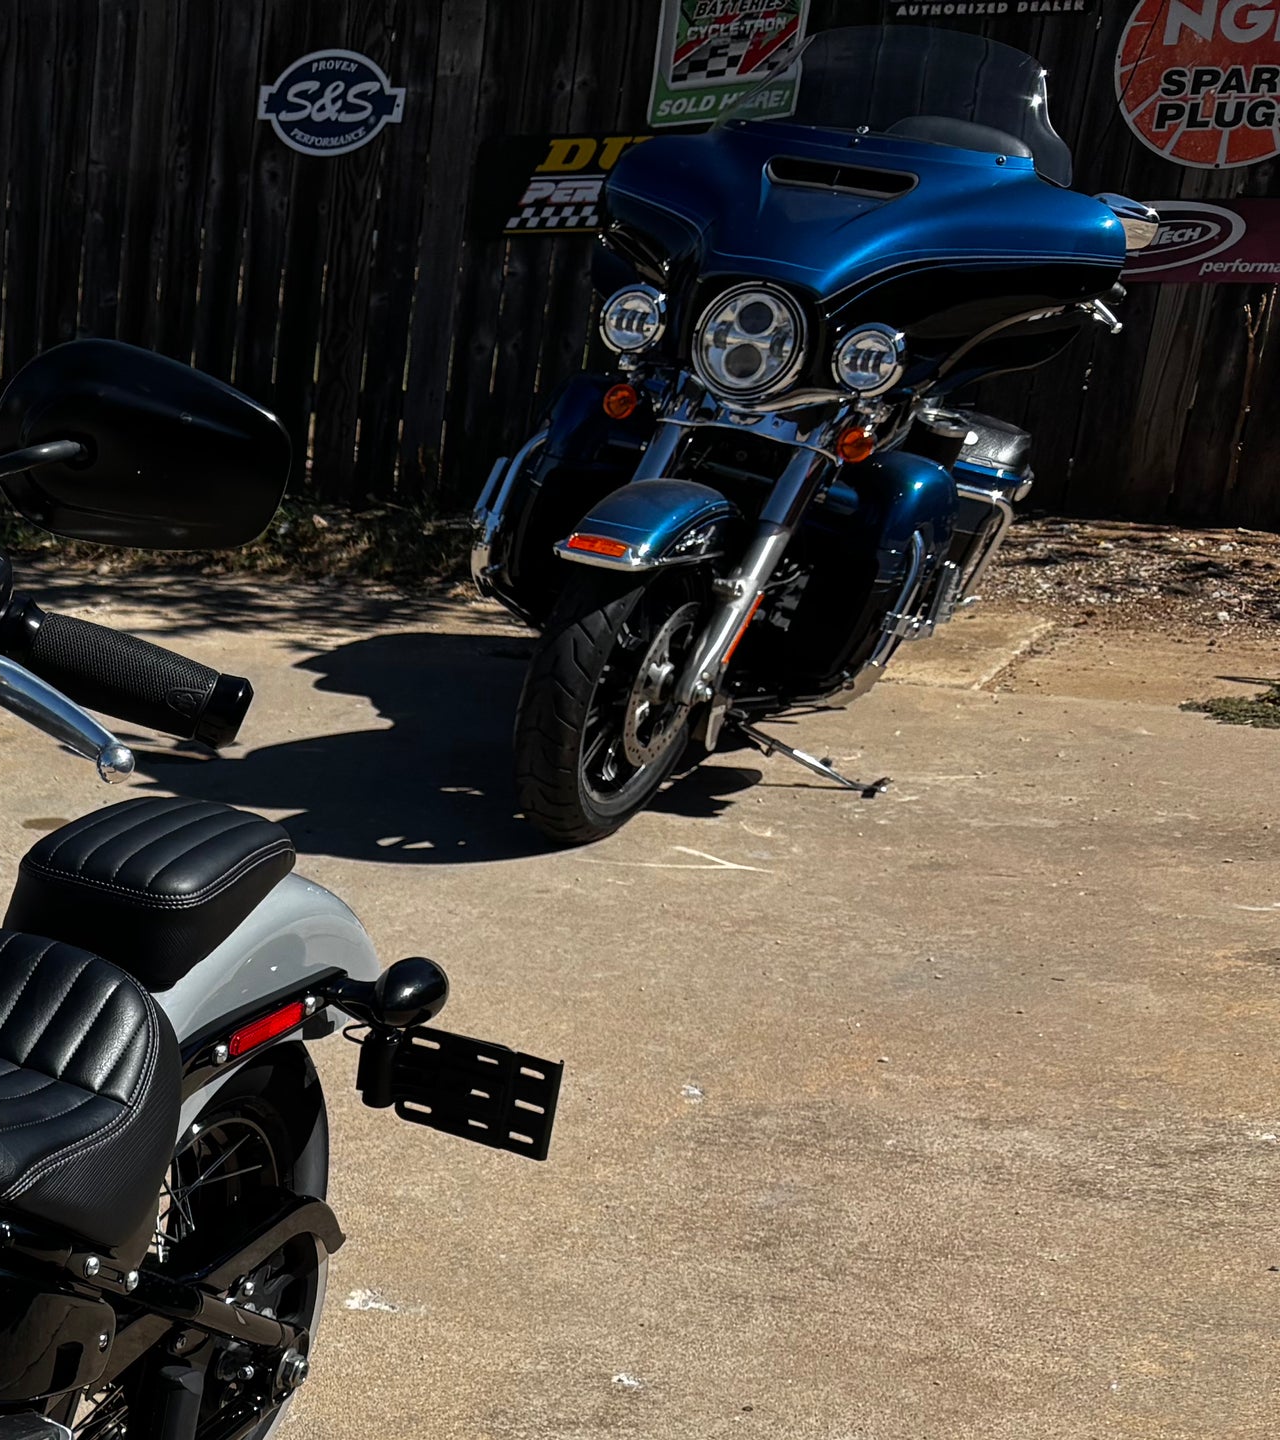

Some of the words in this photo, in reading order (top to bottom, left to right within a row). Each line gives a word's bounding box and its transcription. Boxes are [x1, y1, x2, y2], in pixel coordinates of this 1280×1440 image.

[896, 2, 1009, 16] AUTHORIZED
[1017, 0, 1085, 13] DEALER
[1163, 0, 1280, 46] NG
[311, 59, 359, 73] PROVEN
[278, 80, 382, 123] S&S
[656, 95, 717, 117] SOLD
[1154, 100, 1280, 129] PLUG
[290, 126, 368, 147] PERFORMANCE
